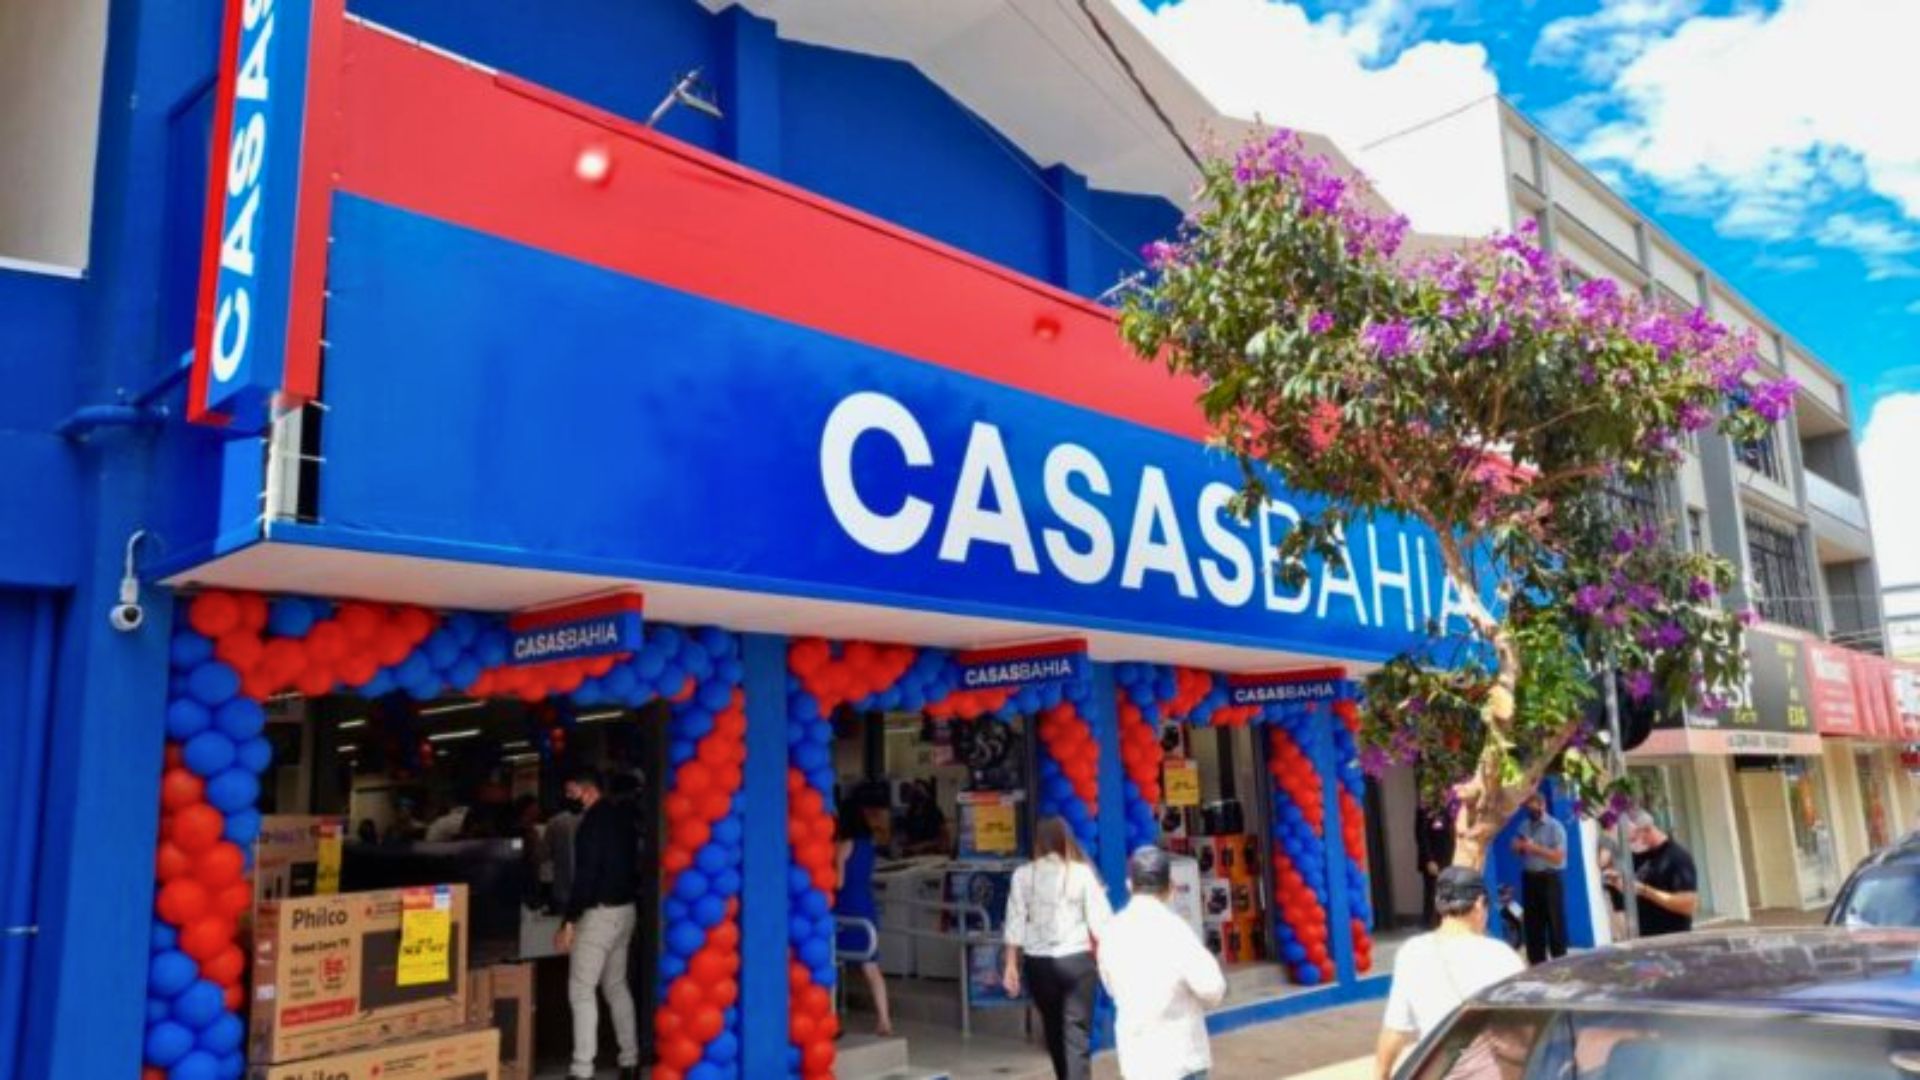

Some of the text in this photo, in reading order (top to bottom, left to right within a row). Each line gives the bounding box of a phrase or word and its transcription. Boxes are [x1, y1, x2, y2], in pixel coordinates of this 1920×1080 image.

[514, 621, 618, 659] CASASBAHIA
[965, 659, 1072, 685] CASASBAHIA
[292, 906, 348, 930] Philco
